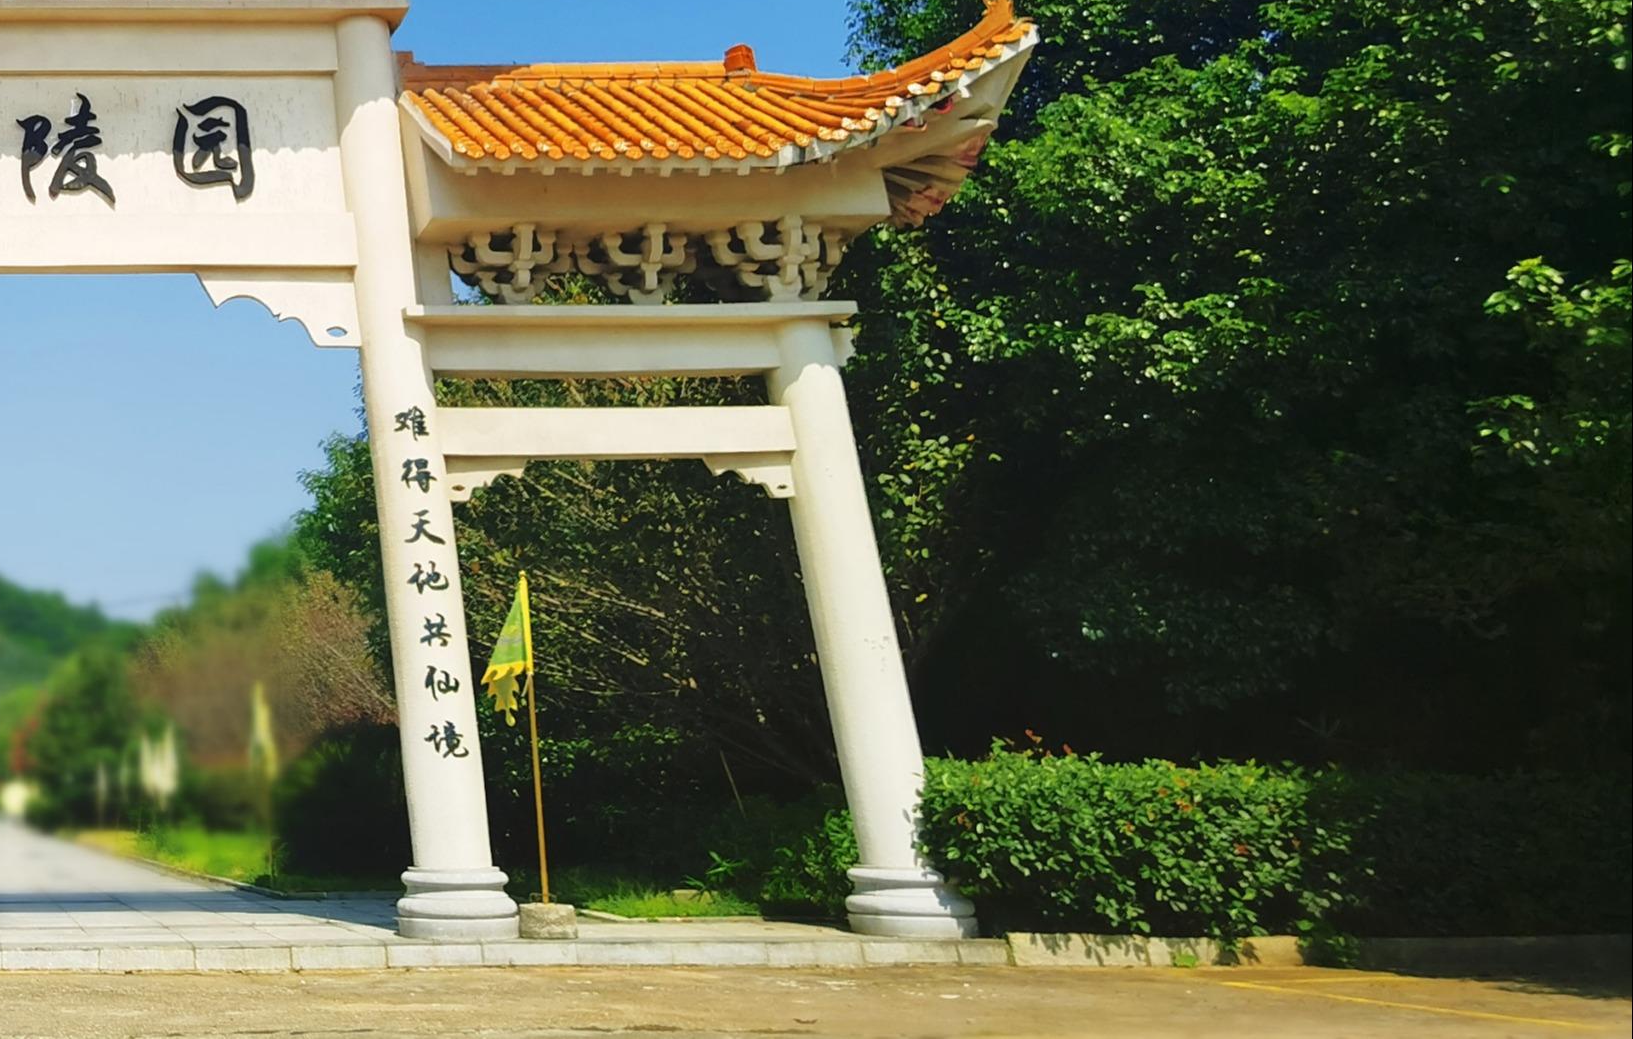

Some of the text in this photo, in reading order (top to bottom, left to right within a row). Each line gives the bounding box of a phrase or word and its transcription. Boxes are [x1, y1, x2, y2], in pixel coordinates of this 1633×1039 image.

[394, 404, 469, 759] 难得天地共仙境
